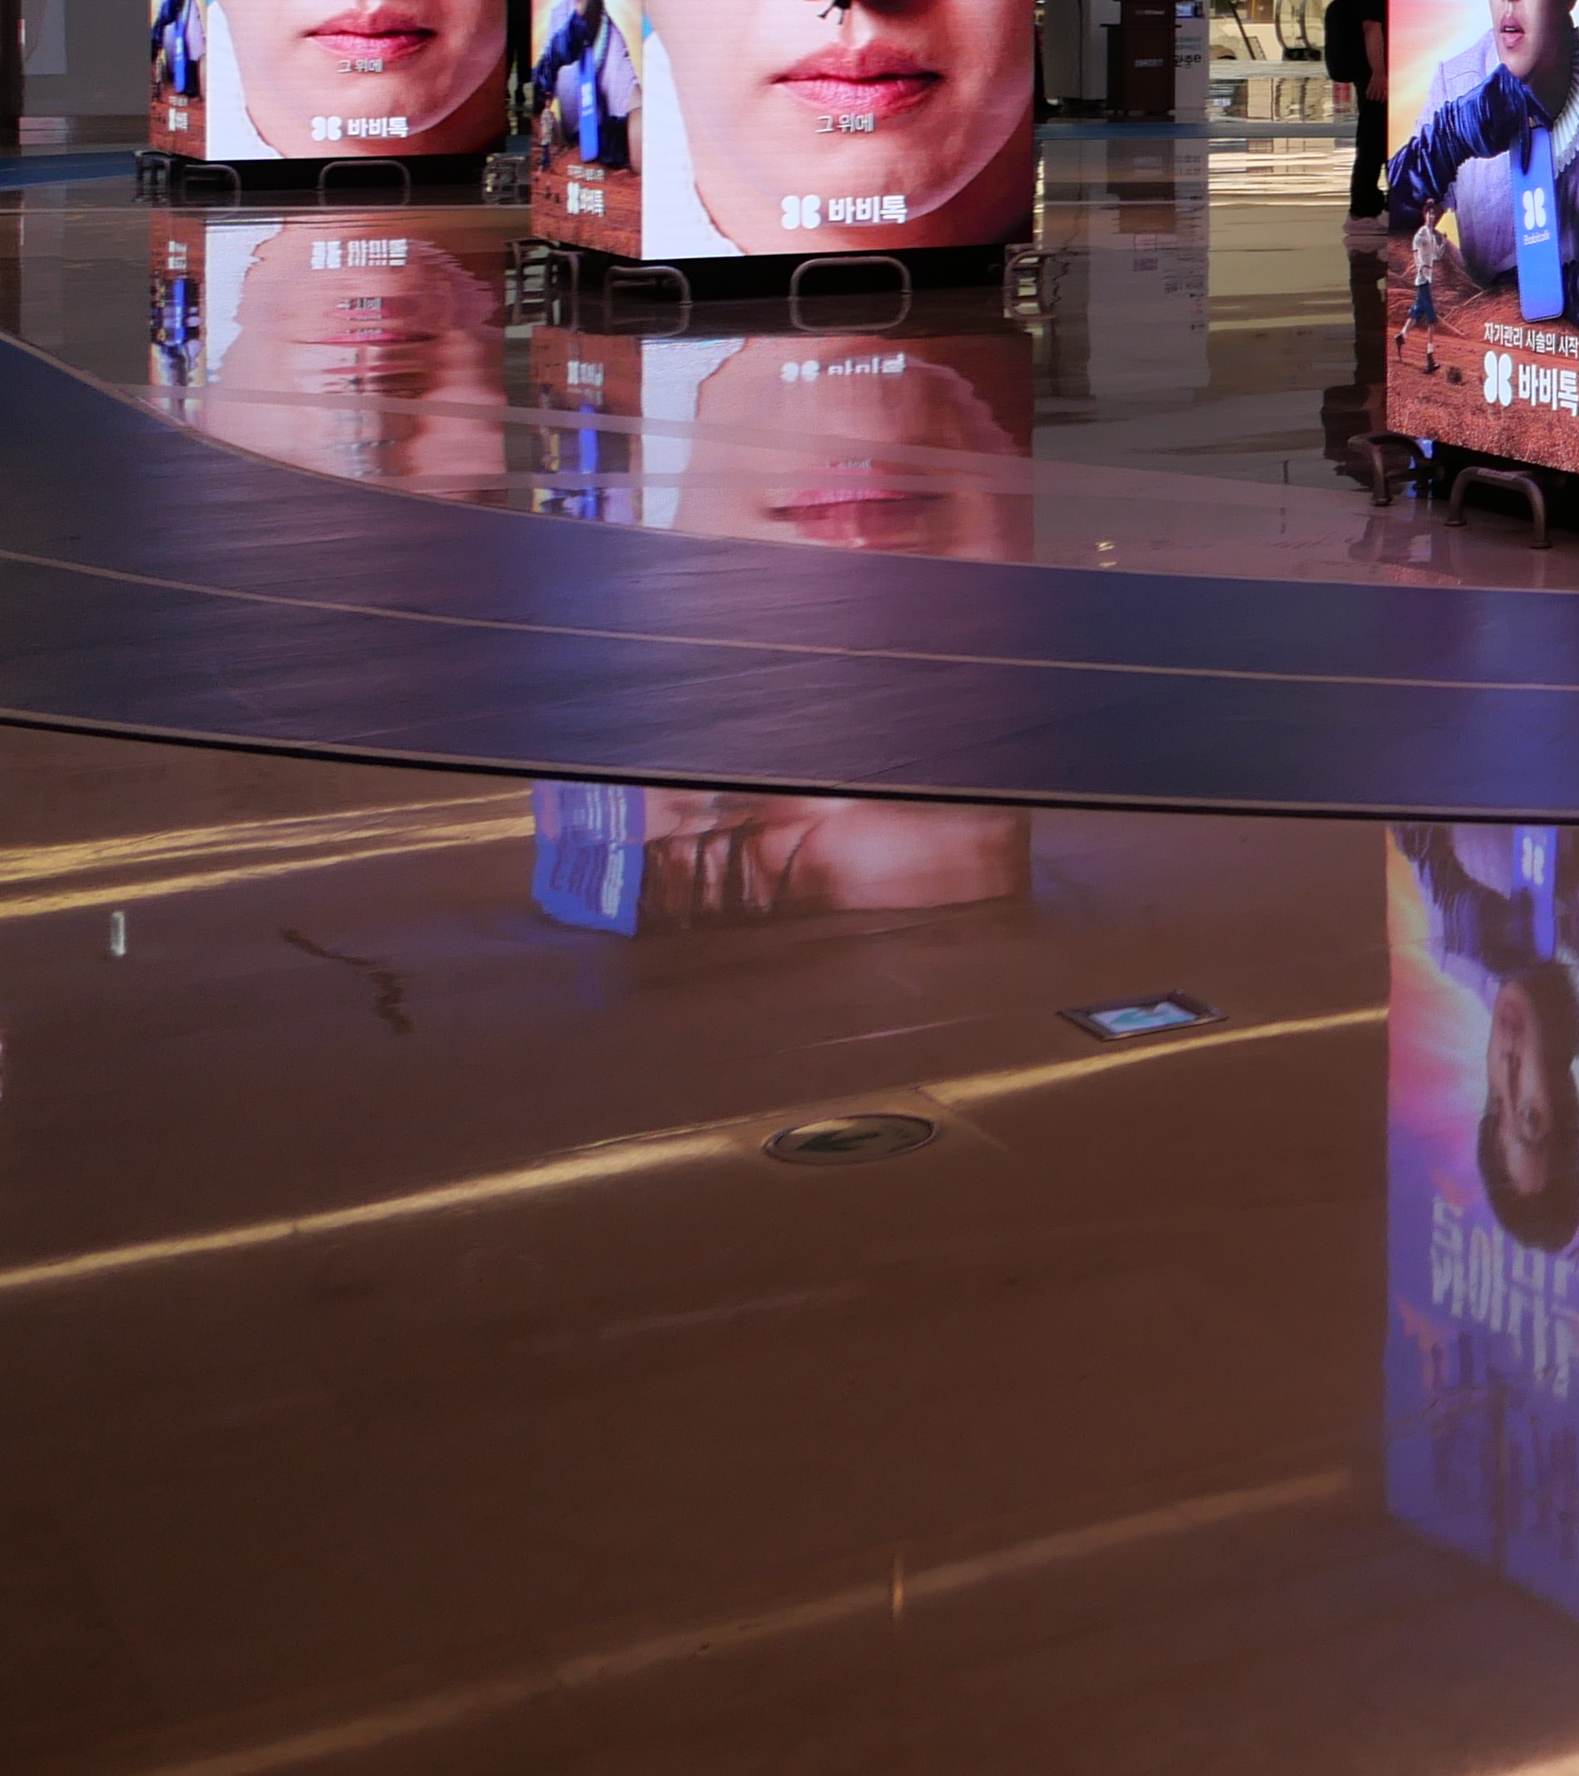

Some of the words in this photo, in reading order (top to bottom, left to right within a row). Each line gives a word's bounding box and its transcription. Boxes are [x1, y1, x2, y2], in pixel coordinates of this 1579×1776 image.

[347, 116, 410, 140] 바비톡
[814, 115, 836, 134] 그
[838, 112, 874, 133] 위에
[828, 194, 908, 224] 바비톡
[1484, 322, 1523, 350] 자기관리
[1525, 329, 1556, 355] 시술의
[1558, 334, 1579, 359] 시작
[1518, 363, 1579, 418] 바비톡
